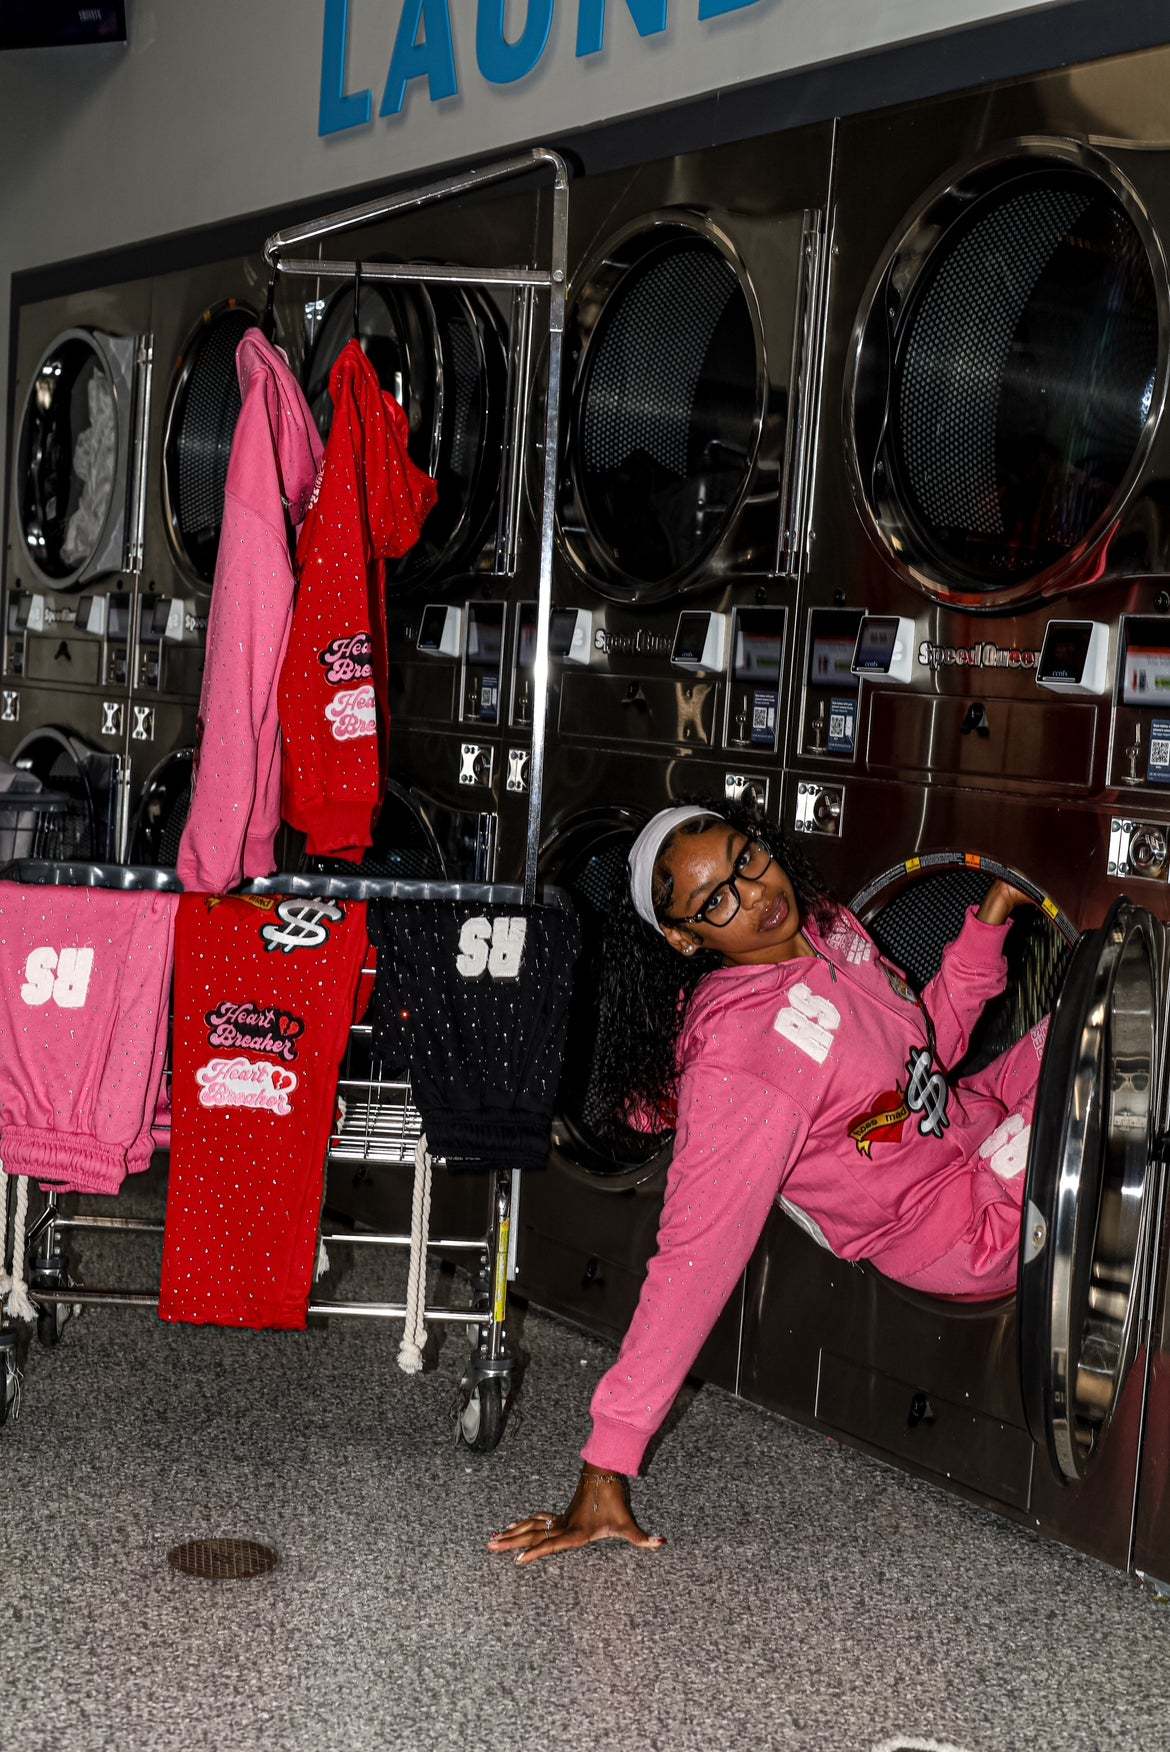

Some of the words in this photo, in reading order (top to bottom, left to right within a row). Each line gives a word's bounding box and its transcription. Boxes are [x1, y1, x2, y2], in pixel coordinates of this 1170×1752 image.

[210, 1003, 276, 1029] Heart
[209, 1024, 295, 1060] Breaker
[201, 1061, 268, 1084] Heart
[885, 1106, 907, 1122] mad
